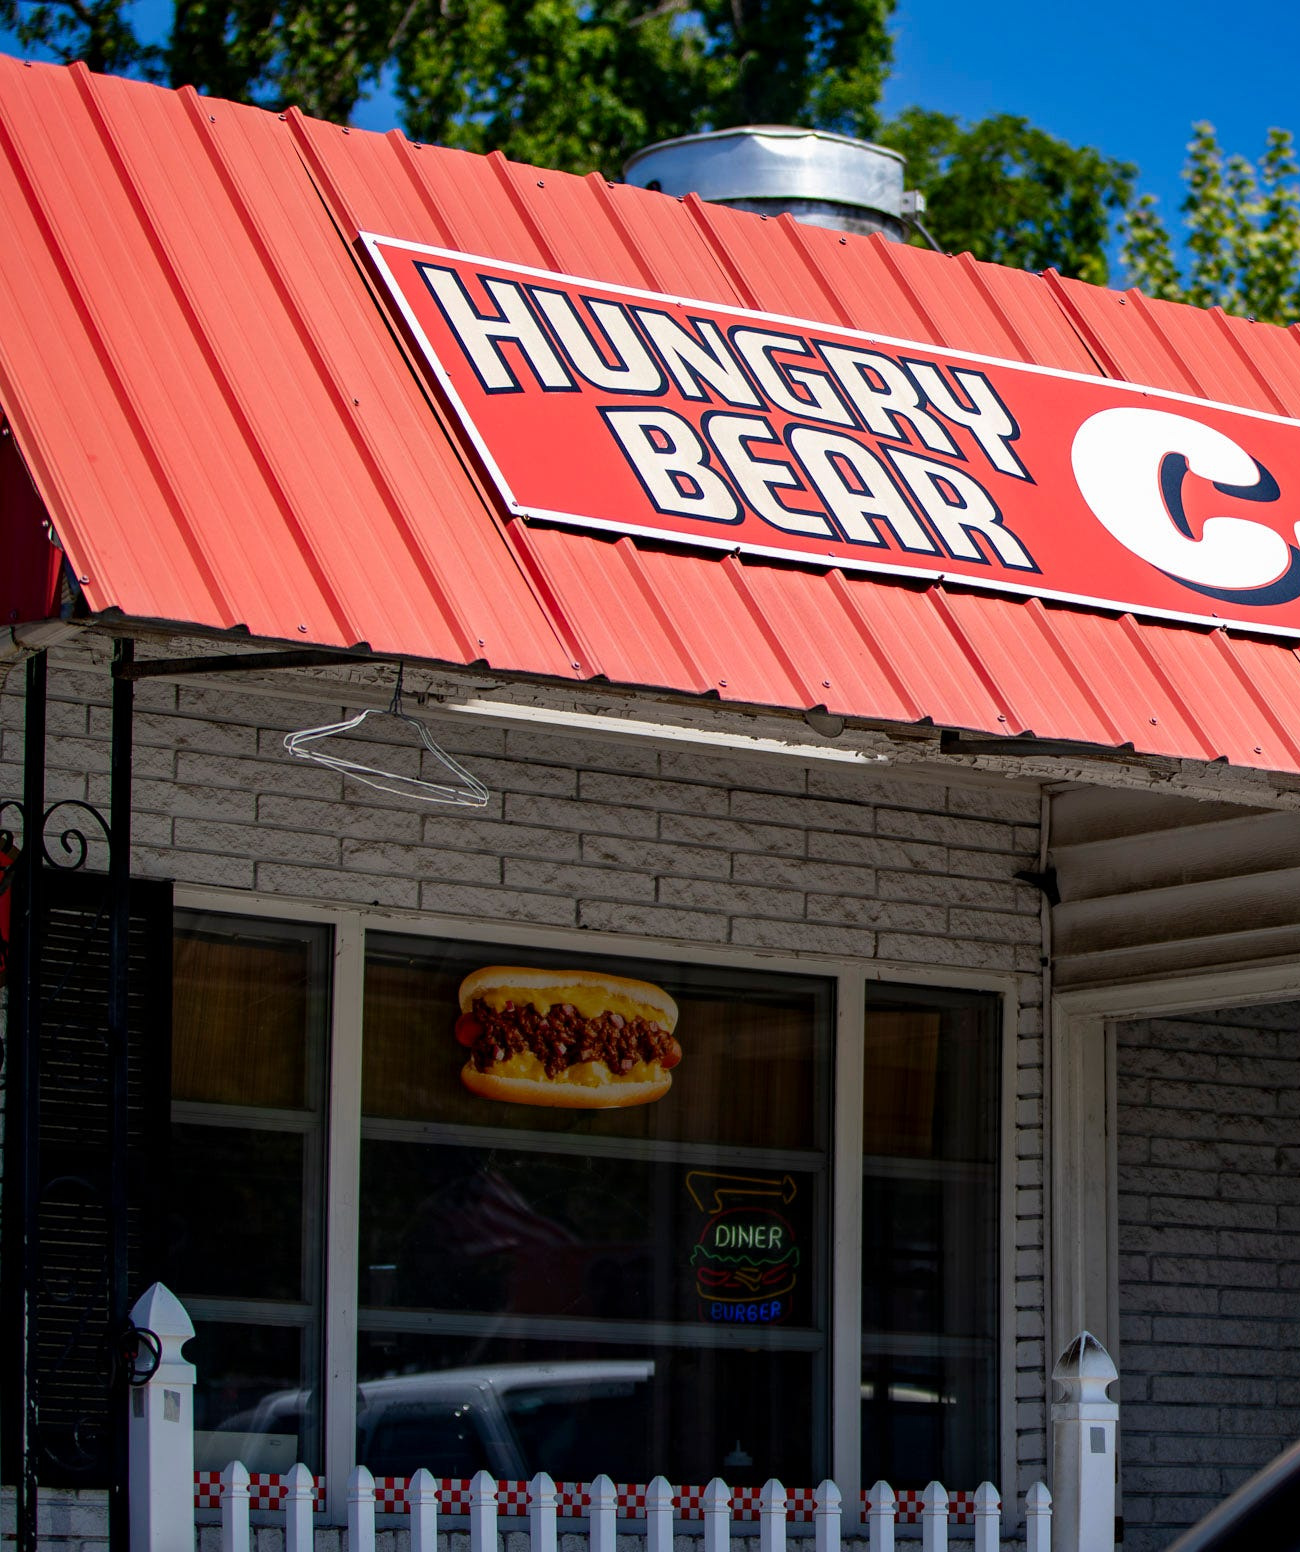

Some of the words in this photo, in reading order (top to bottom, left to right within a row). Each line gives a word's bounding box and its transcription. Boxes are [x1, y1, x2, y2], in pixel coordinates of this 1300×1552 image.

[413, 260, 1036, 485] HUNGRY
[596, 405, 1043, 575] BEAR
[715, 1225, 783, 1249] DINER
[711, 1301, 782, 1323] BURGER
